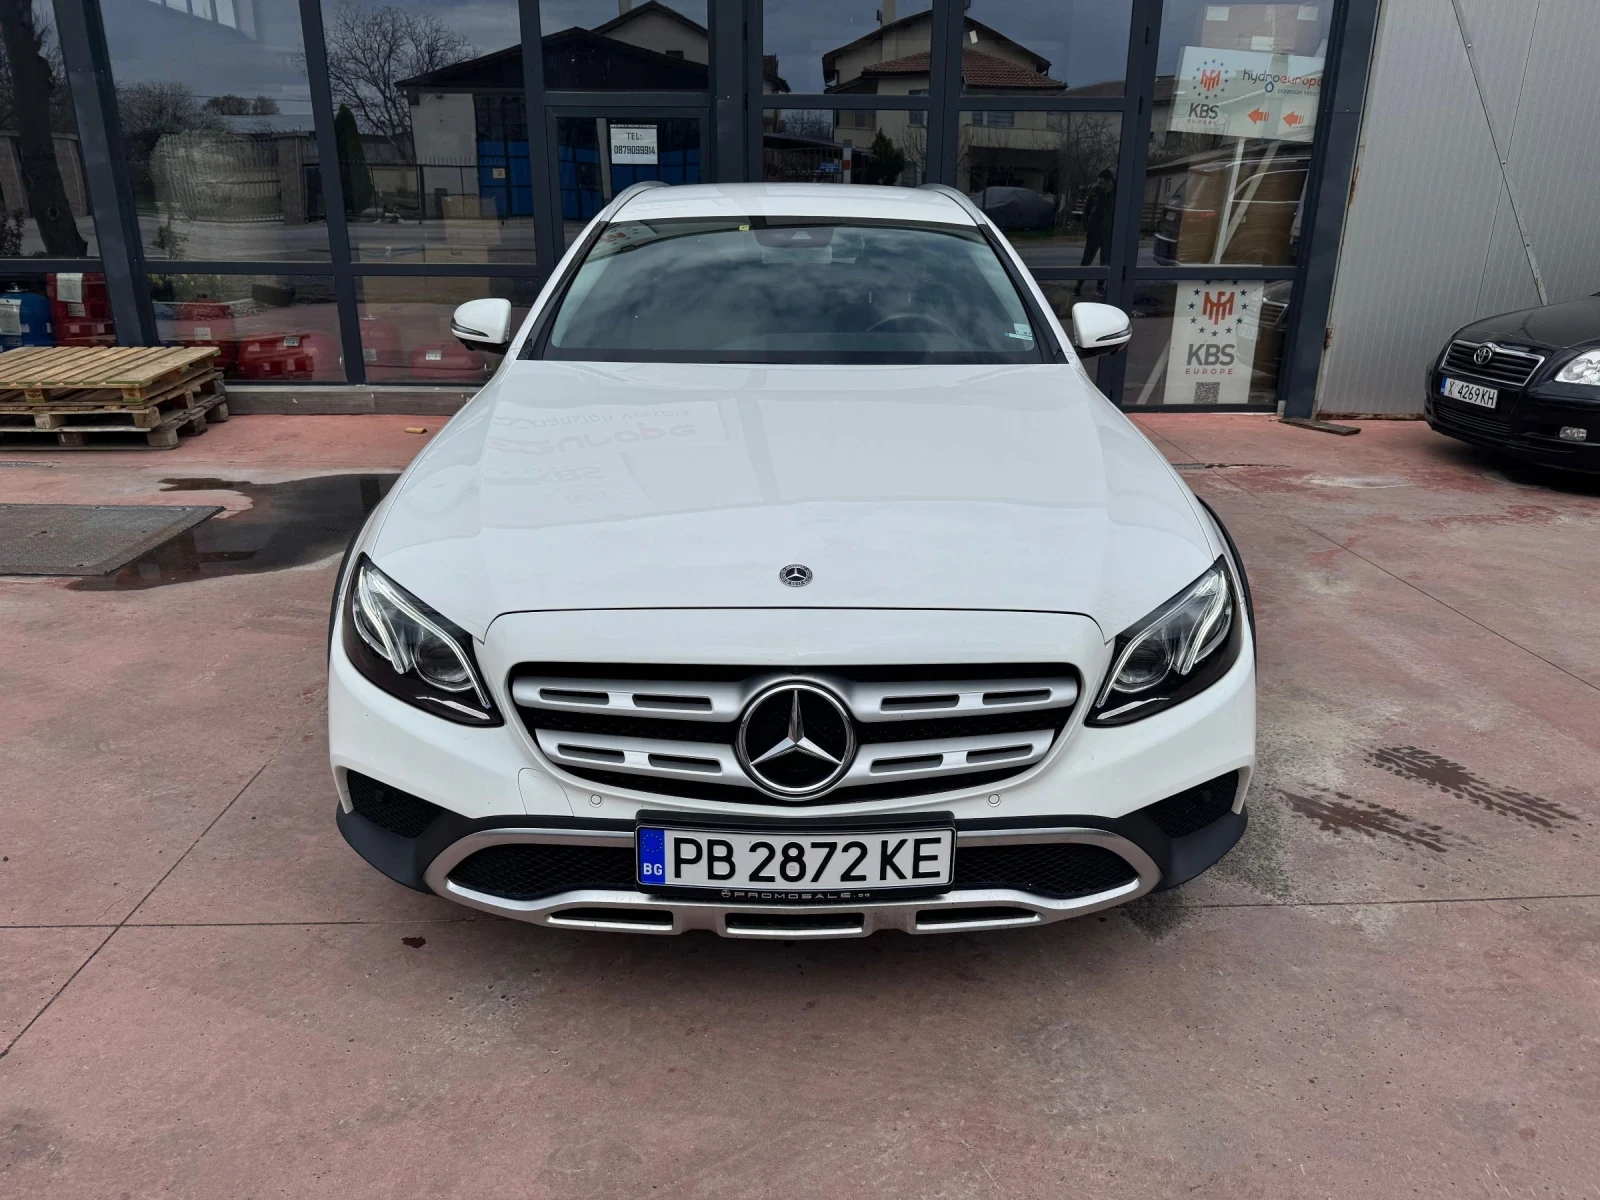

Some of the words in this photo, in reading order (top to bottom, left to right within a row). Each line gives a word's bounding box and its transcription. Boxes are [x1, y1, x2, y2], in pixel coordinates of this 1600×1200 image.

[1188, 103, 1219, 119] KBS
[625, 131, 643, 141] TEL:
[1186, 343, 1236, 366] KBS
[643, 862, 663, 876] BG
[673, 836, 736, 881] PB
[748, 840, 868, 883] 2872
[879, 836, 942, 881] KE
